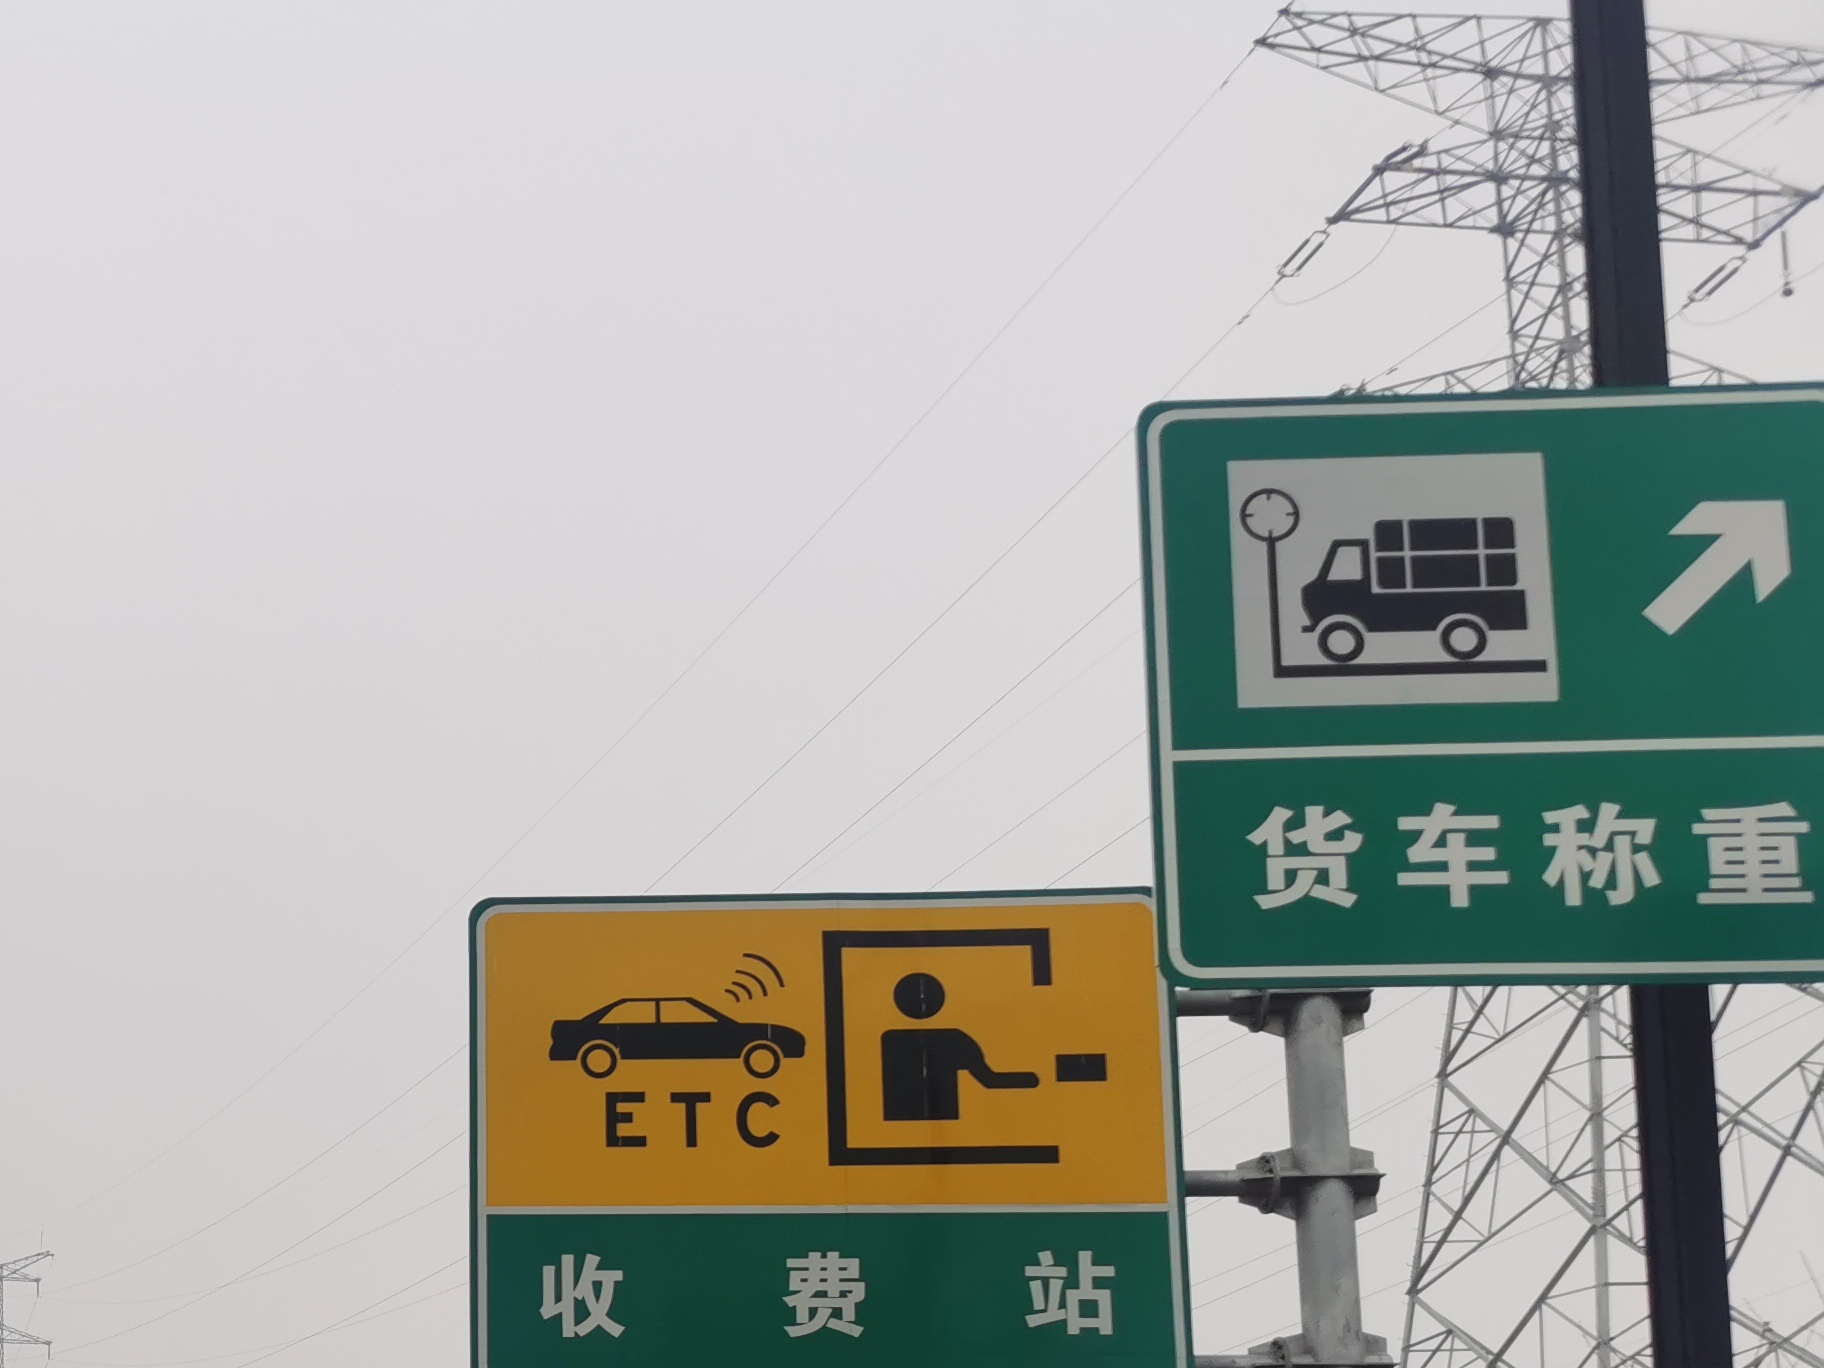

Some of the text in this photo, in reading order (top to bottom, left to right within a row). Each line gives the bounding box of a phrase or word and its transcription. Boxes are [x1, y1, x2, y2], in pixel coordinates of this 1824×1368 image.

[1246, 800, 1816, 911] 货车称重
[604, 1090, 781, 1149] ETC
[538, 1250, 1116, 1339] 收费站
